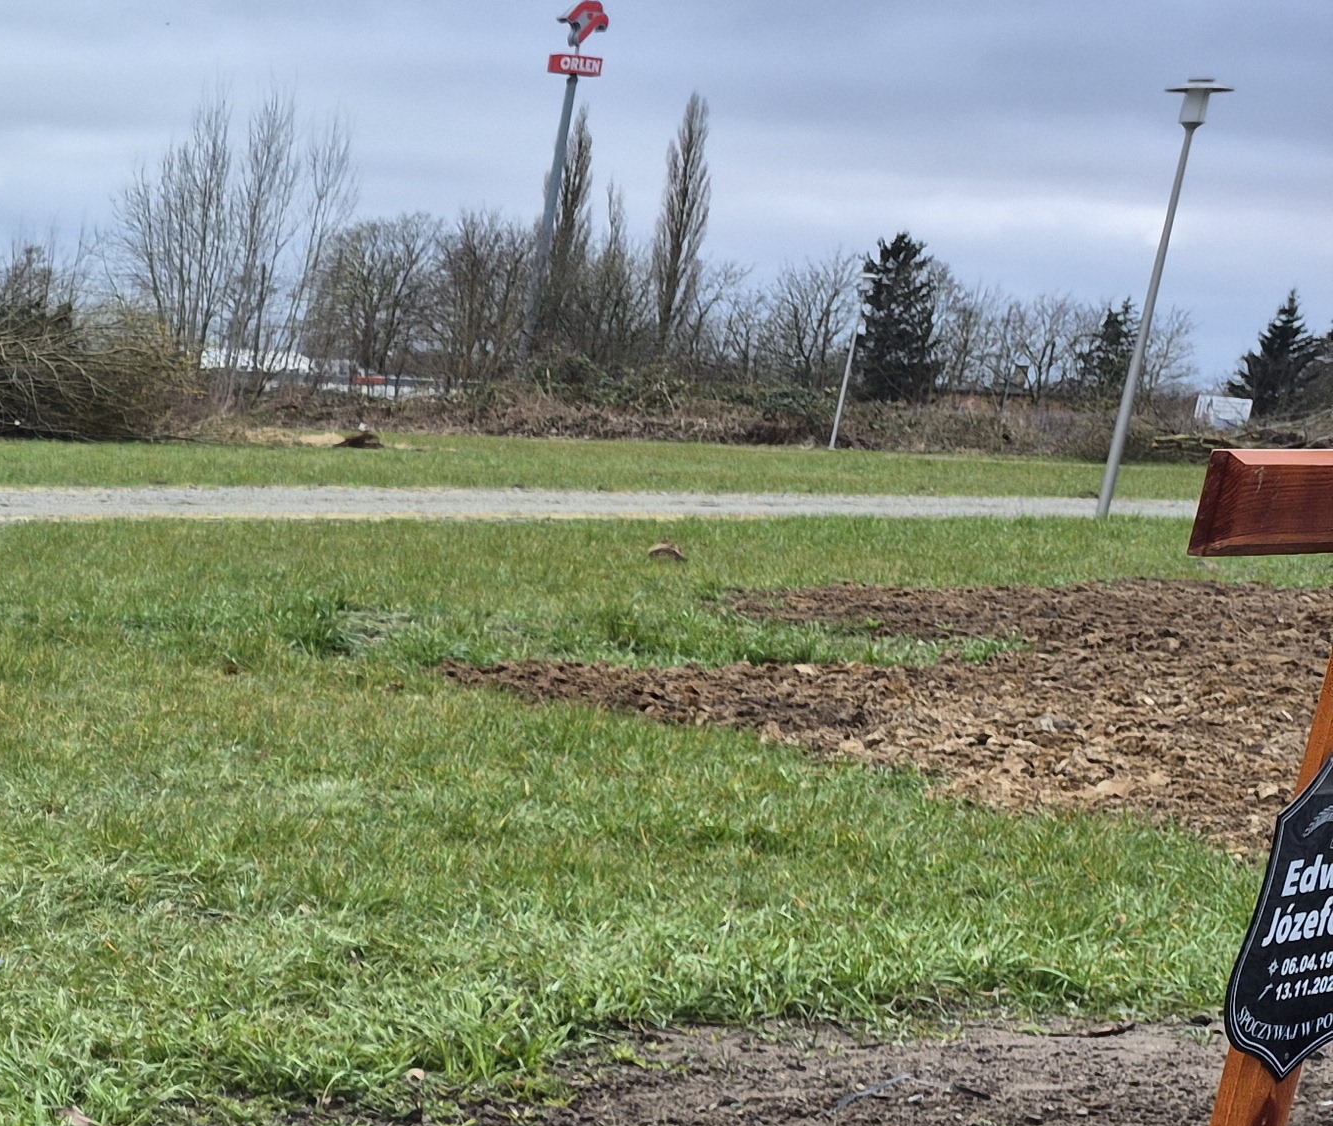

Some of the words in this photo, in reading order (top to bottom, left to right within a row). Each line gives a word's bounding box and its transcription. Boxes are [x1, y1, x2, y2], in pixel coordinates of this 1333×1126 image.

[560, 57, 600, 73] ORLEN
[1236, 1005, 1299, 1041] SPOCZYWAJ
[1301, 1019, 1315, 1037] W
